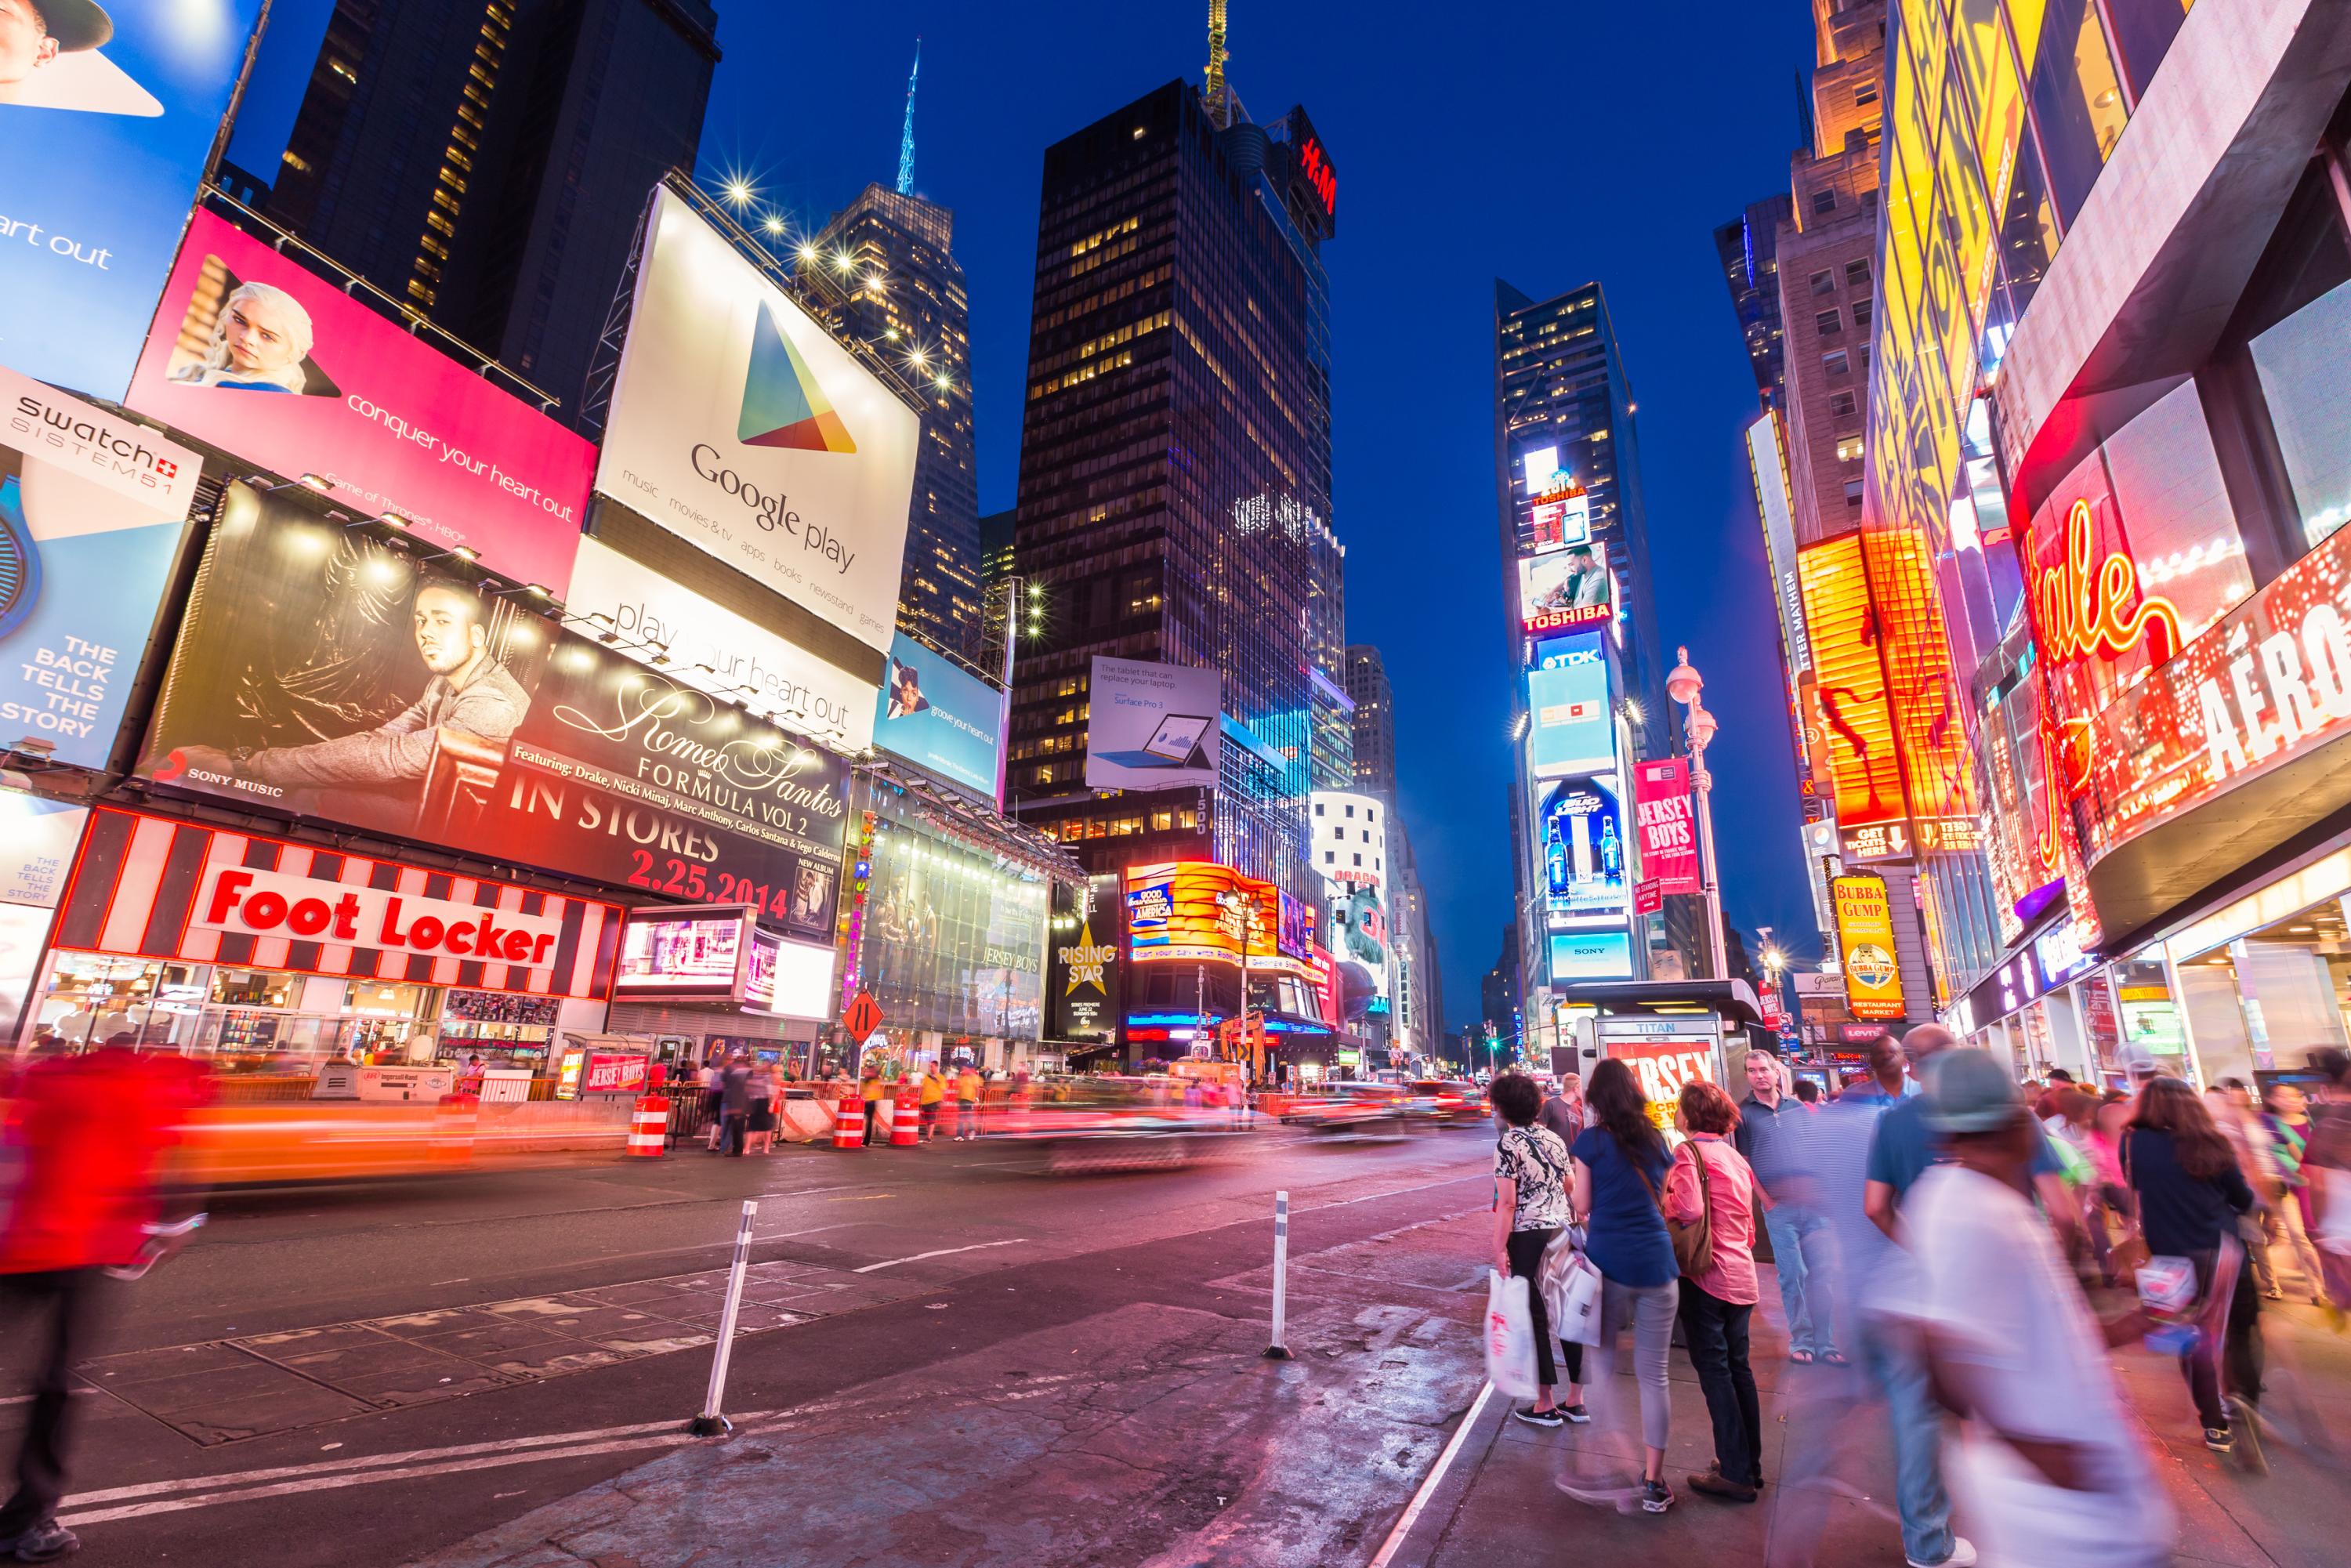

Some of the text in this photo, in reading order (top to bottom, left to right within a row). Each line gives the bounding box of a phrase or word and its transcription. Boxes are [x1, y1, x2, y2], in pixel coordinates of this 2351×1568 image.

[1302, 138, 1336, 215] H&M
[1994, 137, 2011, 220] STREET
[49, 236, 113, 270] out
[17, 397, 154, 469] swatch
[10, 417, 172, 495] SISTEM51
[347, 394, 573, 523] conquer your heart out
[325, 473, 363, 497] Game
[364, 493, 379, 504] of
[690, 444, 800, 534] Google
[1534, 487, 1586, 506] TOSHIBA
[622, 469, 885, 634] music movies & tv apps books newsstand games
[804, 523, 855, 574] play
[1523, 603, 1610, 632] TOSHIBA
[1784, 570, 1811, 672] TTER MAYHEM
[65, 635, 118, 665] THE
[1554, 649, 1599, 668] TDK
[34, 647, 112, 684] BACK
[614, 603, 849, 730] play our heart out
[1101, 664, 1116, 673] The
[1118, 666, 1139, 676] tablet
[1141, 669, 1157, 678] that
[21, 664, 105, 701] TELLS
[1100, 674, 1129, 683] replace
[1150, 679, 1177, 690] laptop.
[45, 692, 100, 721] THE
[1114, 696, 1142, 707] Surface
[1143, 700, 1157, 708] Pro
[0, 702, 94, 738] STORY
[930, 705, 994, 746] groove your heart out
[552, 672, 842, 819] Romeo Santos
[187, 768, 284, 798] SONY MUSIC
[514, 745, 841, 863] Featuring: Drake, Nicki Minaj, Marc Anthony, Carlos Santana & Tego Calderon
[637, 757, 808, 836] FORMULA VOL 2
[1554, 802, 1603, 816] LIGHT
[1563, 796, 1601, 808] BUD
[509, 773, 719, 864] IN STORES
[1637, 794, 1693, 827] JERSEY
[1646, 820, 1691, 850] BOYS
[1845, 838, 1886, 850] TICKETS
[1857, 827, 1885, 839] GET
[38, 856, 60, 867] THE
[799, 858, 813, 869] NEW
[1857, 846, 1888, 857] HERE
[17, 872, 53, 884] TELLS
[24, 864, 56, 875] BACK
[813, 861, 834, 875] ALBUM
[8, 889, 48, 900] STORY
[27, 882, 51, 893] THE
[628, 849, 788, 918] 2.25.2014
[1141, 889, 1162, 899] GOOD
[1635, 881, 1659, 893] NO STANDING
[1836, 884, 1883, 900] BUBBA
[1638, 893, 1657, 902] ANYTIME
[1842, 902, 1882, 917] GUMP
[204, 870, 555, 964] Foot Locker
[1136, 905, 1173, 921] AMERICA
[982, 947, 1038, 972] JERSEY BOYS
[1059, 945, 1117, 964] RISING
[1068, 965, 1104, 983] STAR
[1849, 963, 1895, 975] BUBBA GUMP
[1636, 1023, 1675, 1033] TITAN
[589, 1066, 621, 1087] JERSEY
[622, 1063, 645, 1081] BOYS
[1626, 1050, 1712, 1102] RSEY
